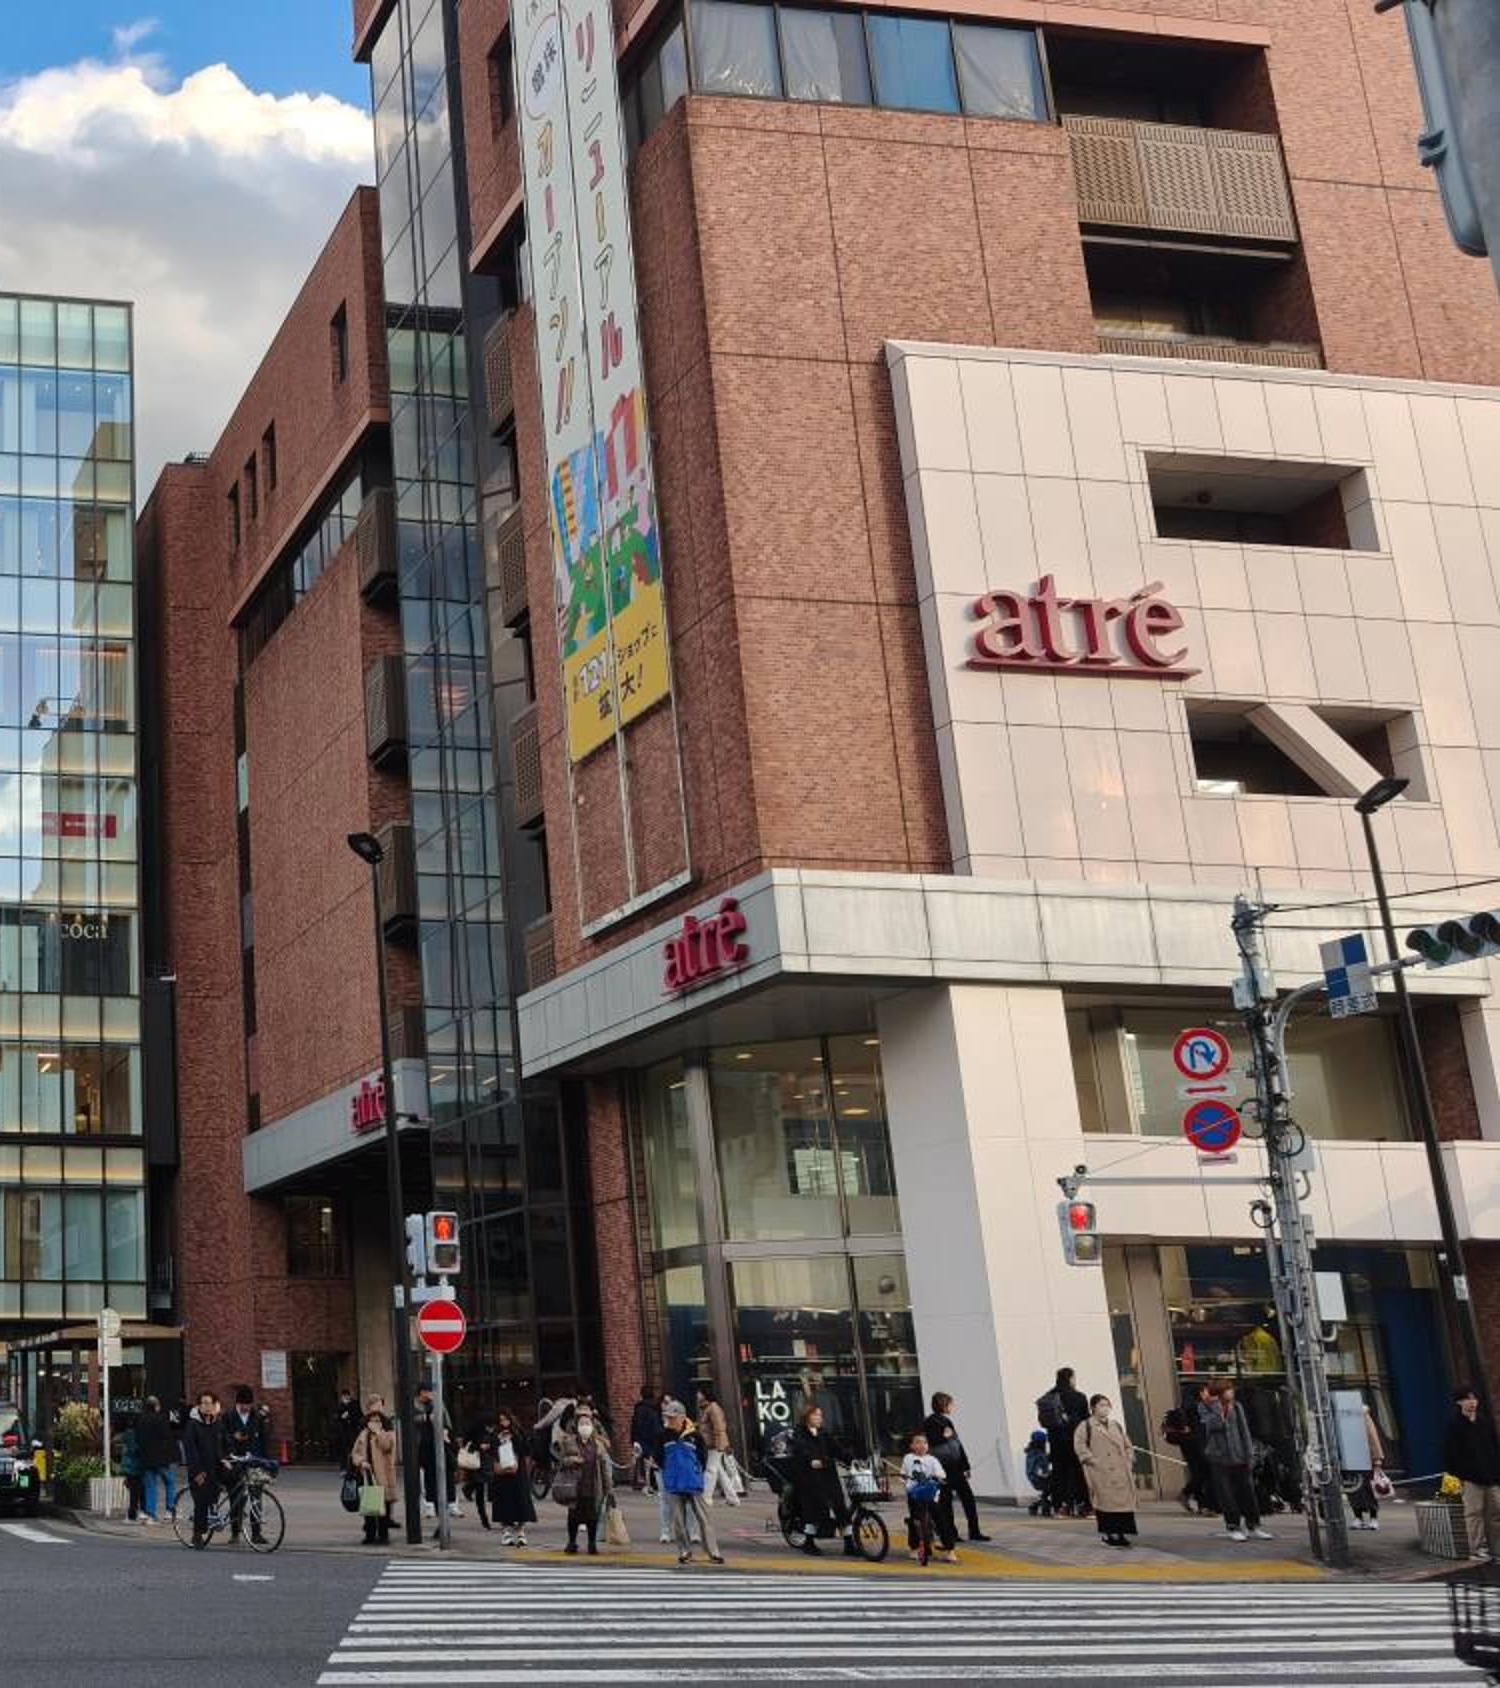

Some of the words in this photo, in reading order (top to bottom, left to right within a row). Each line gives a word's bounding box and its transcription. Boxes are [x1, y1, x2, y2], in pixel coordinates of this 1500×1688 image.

[970, 573, 1190, 670] atré
[662, 897, 750, 991] atré
[755, 1379, 787, 1400] LA
[757, 1401, 791, 1422] KO
